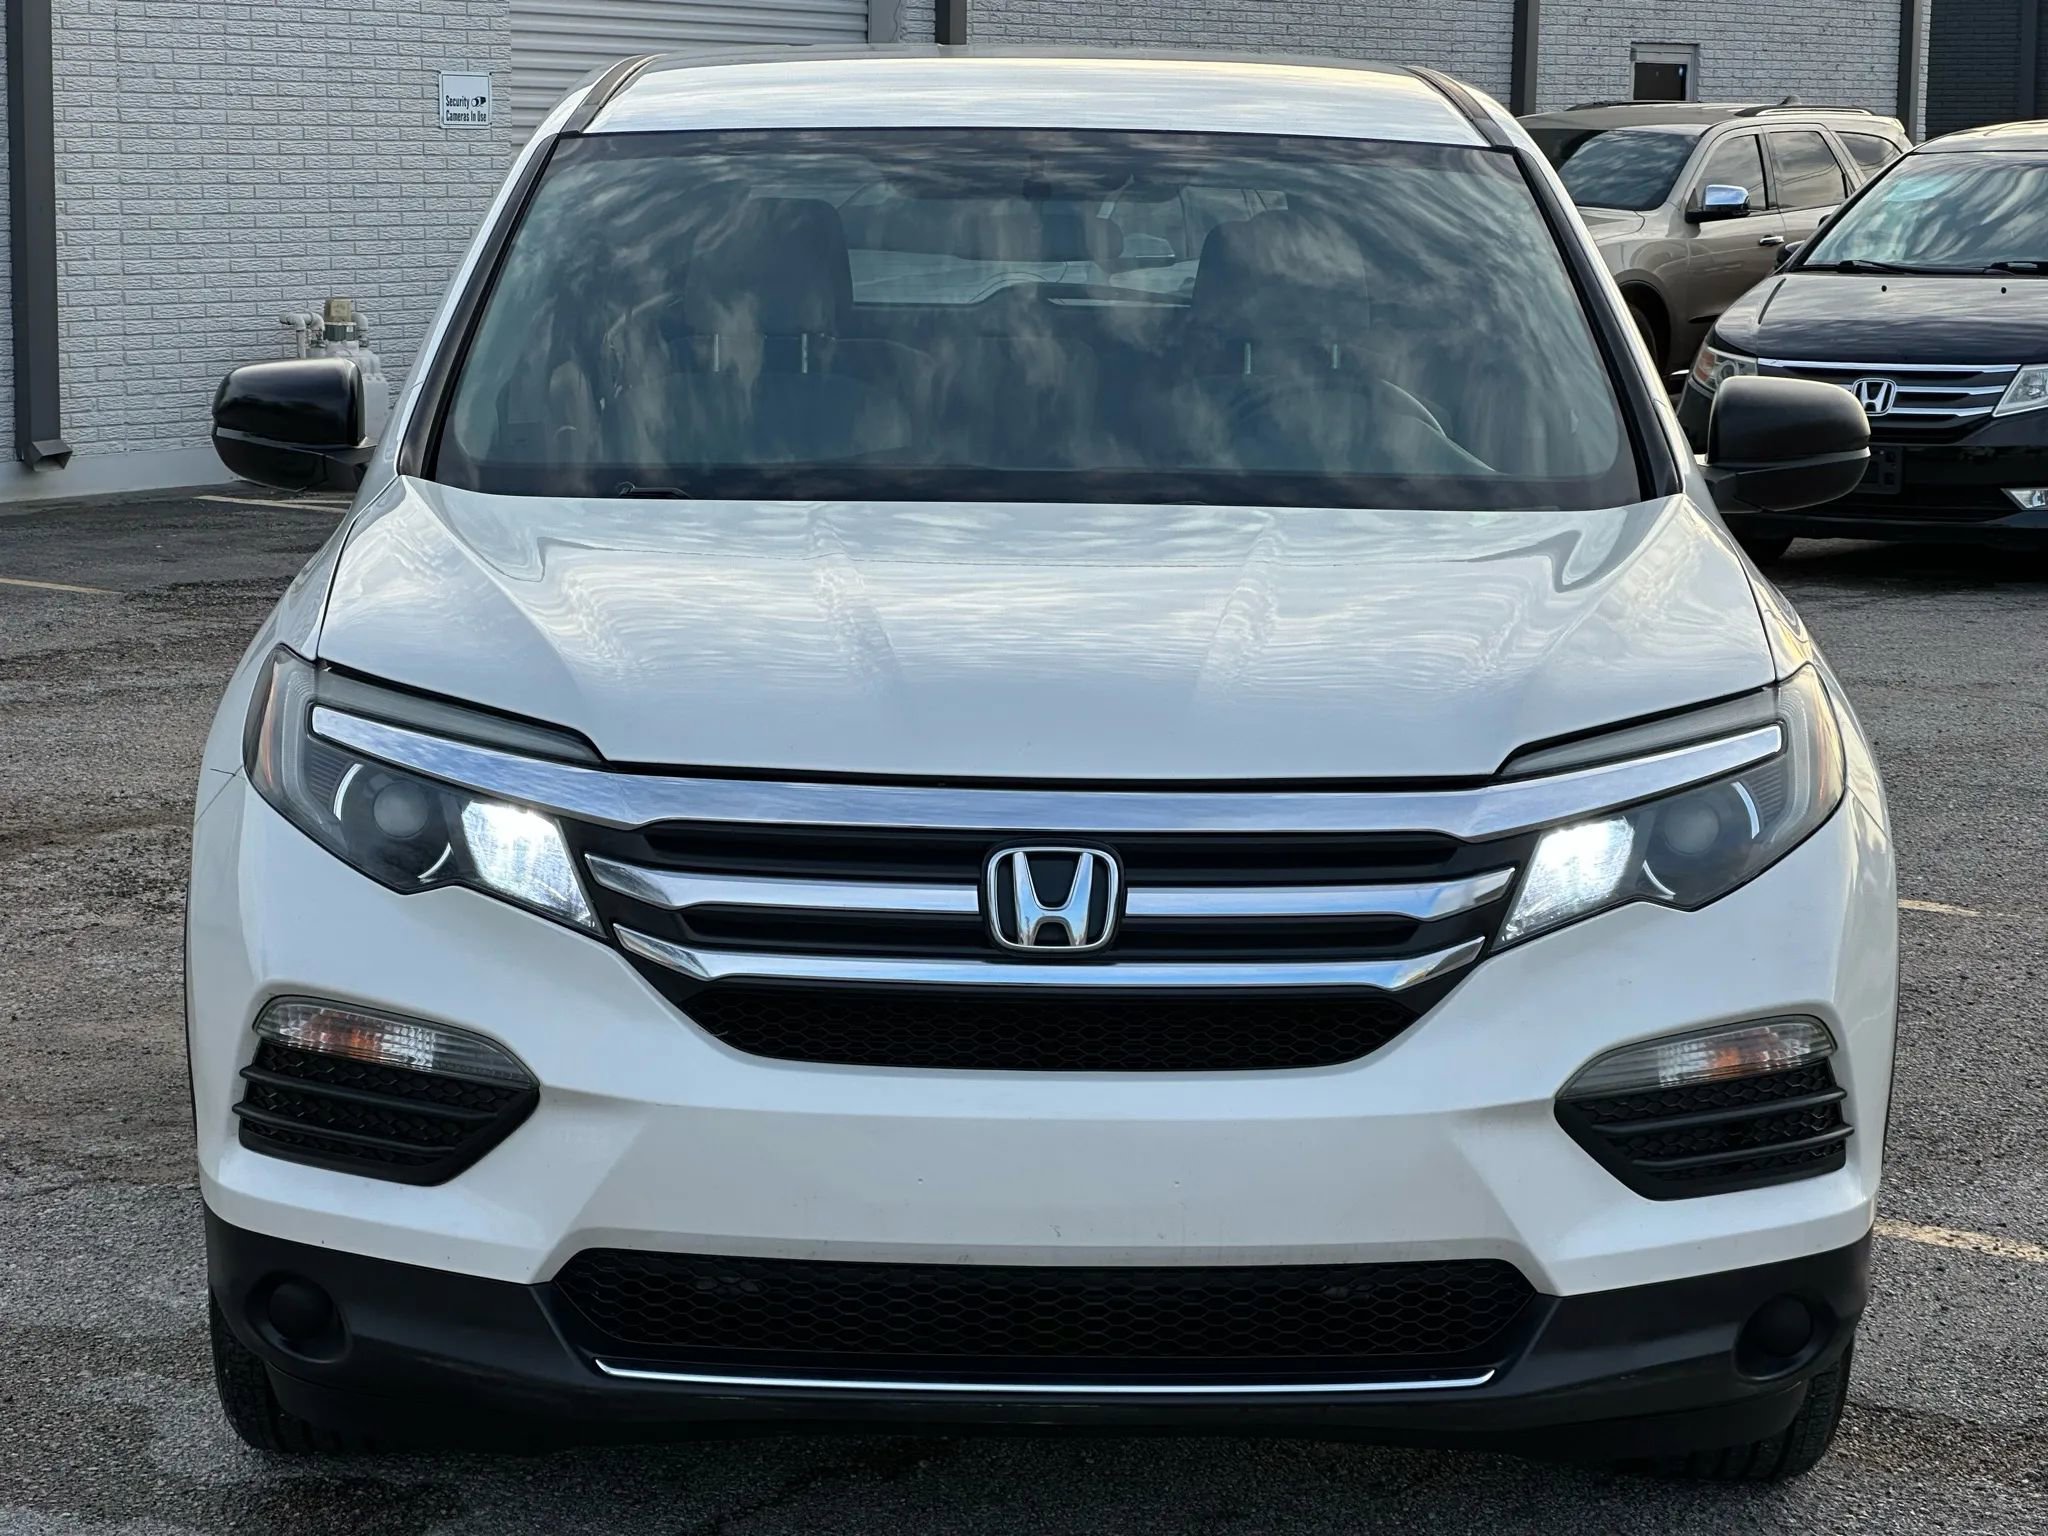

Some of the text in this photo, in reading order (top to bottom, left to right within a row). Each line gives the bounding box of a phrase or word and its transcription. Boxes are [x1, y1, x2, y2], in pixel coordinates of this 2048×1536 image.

[446, 95, 470, 109] Security
[446, 110, 486, 121] Cameras In Use
